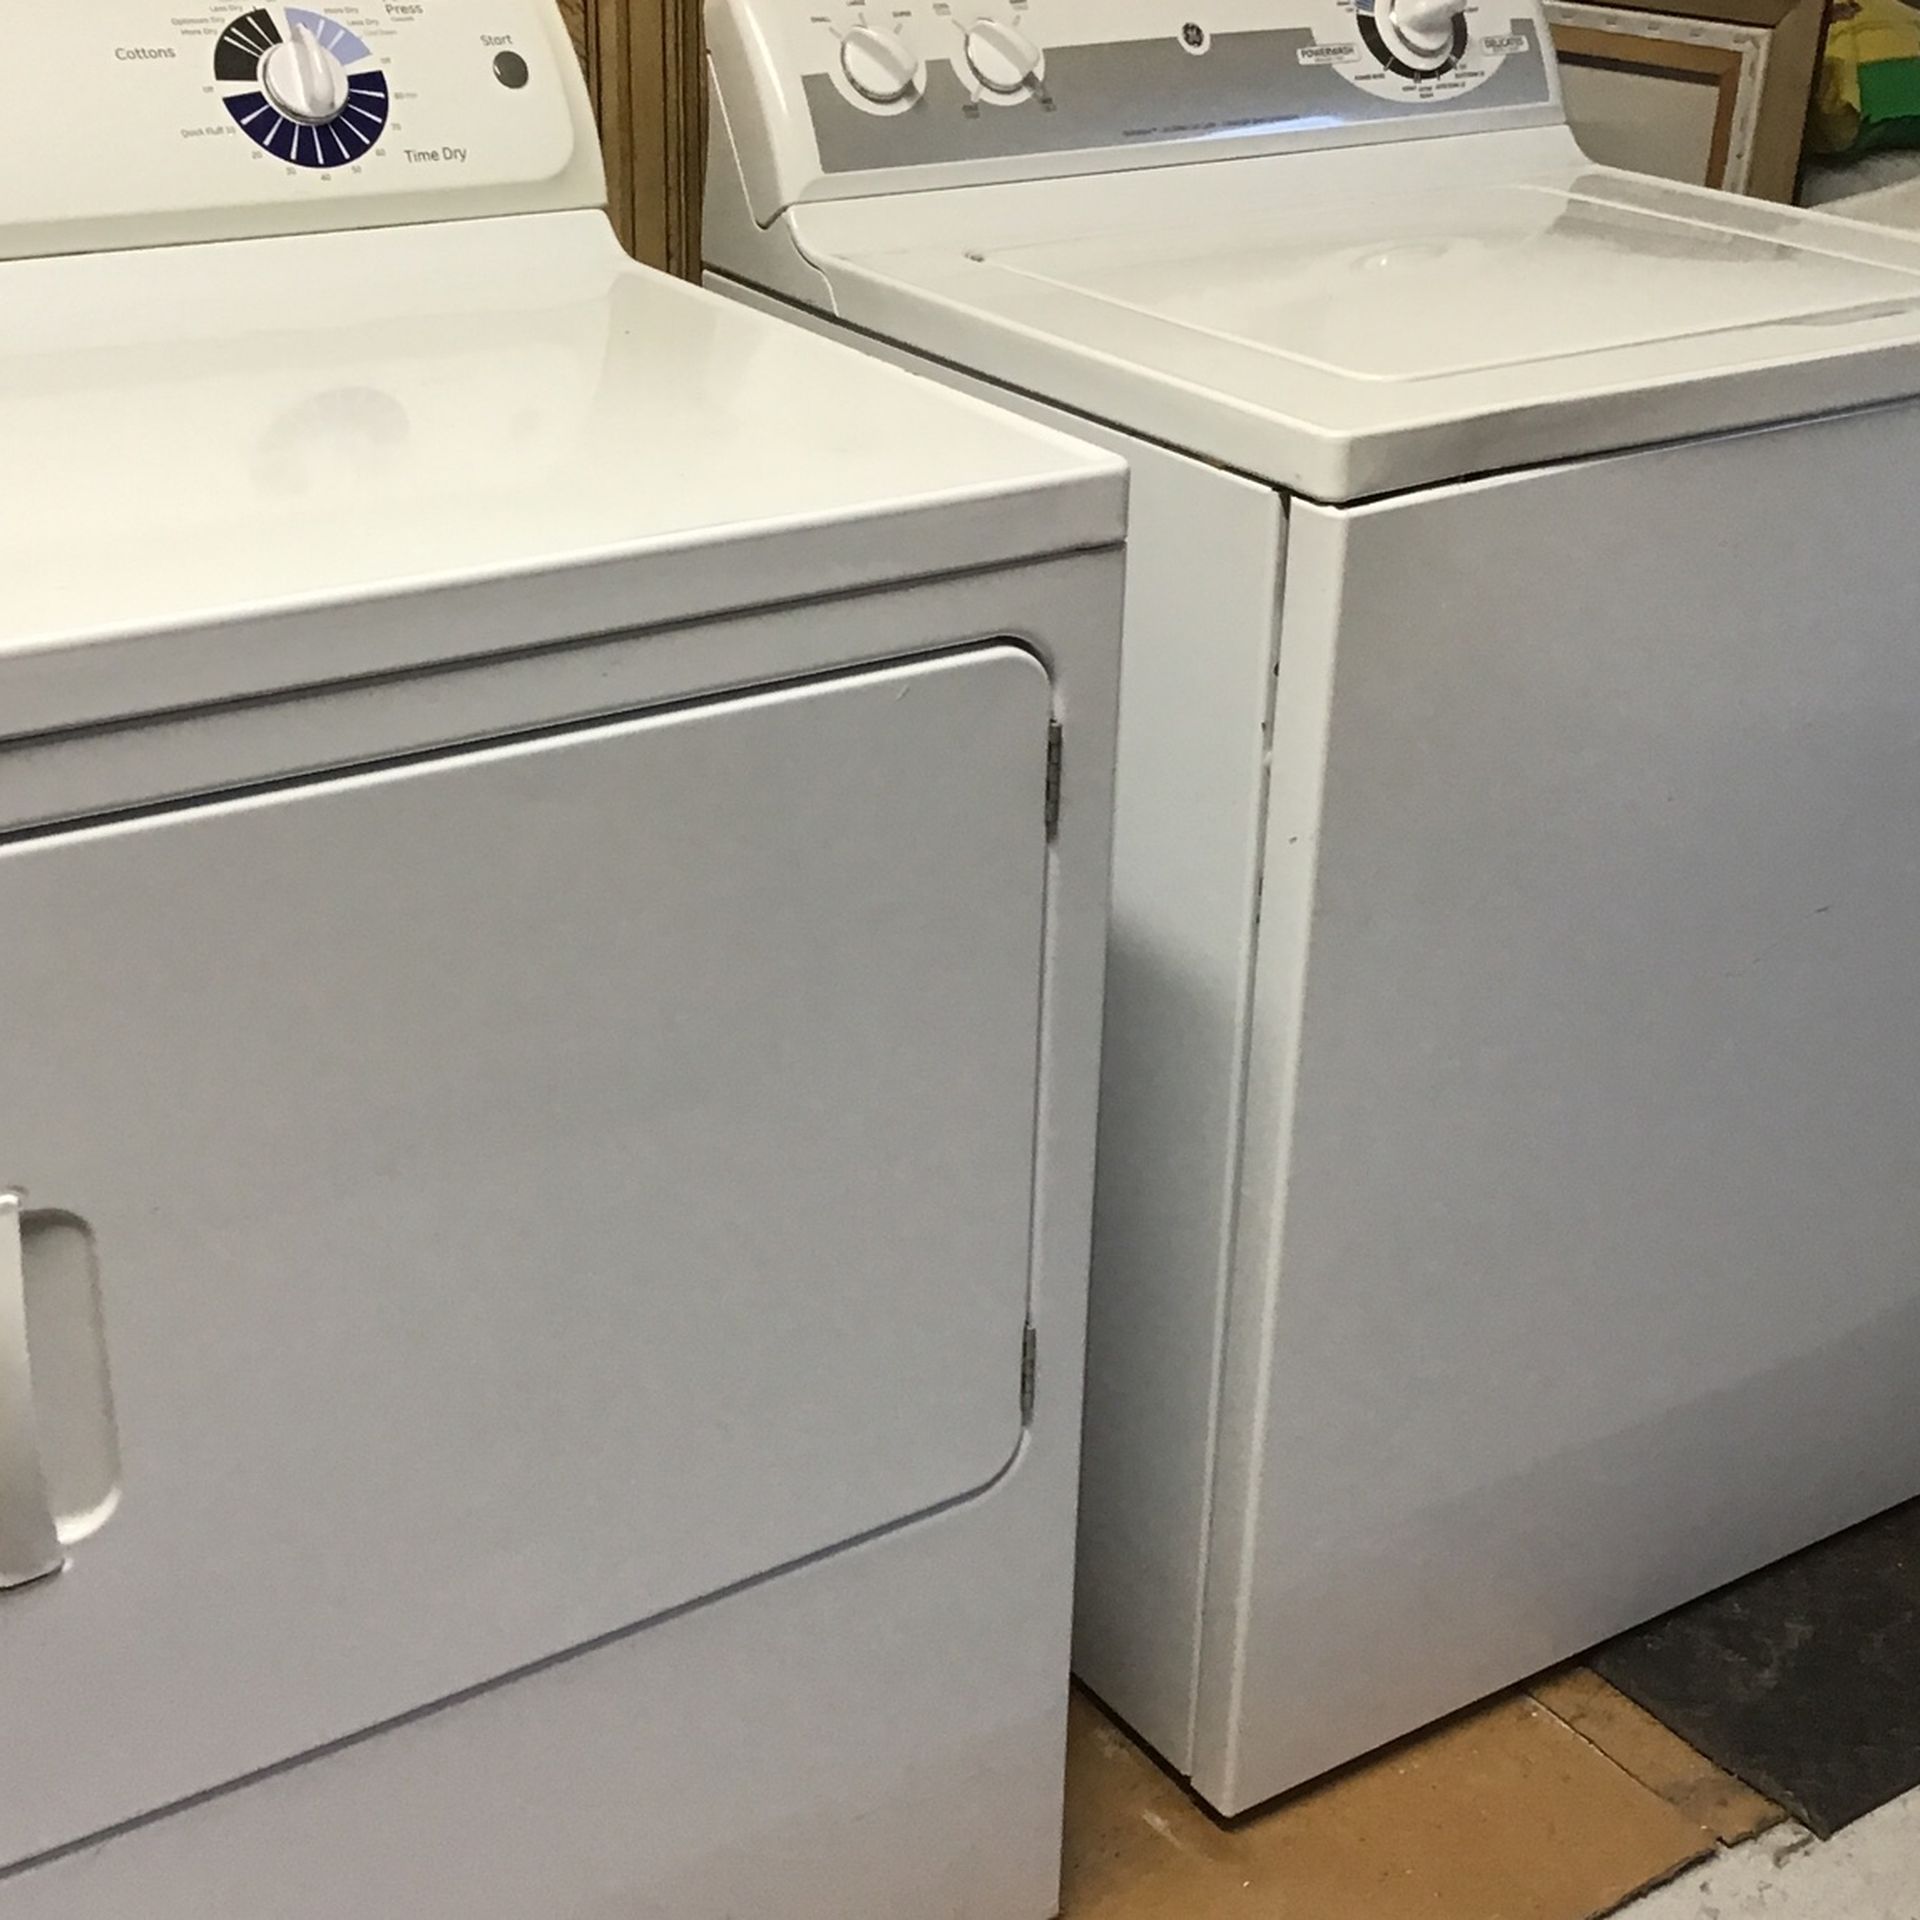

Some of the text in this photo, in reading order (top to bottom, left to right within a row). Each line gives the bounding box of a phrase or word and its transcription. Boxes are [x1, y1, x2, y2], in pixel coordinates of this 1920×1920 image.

[385, 4, 423, 14] Press
[480, 34, 512, 46] Start
[115, 47, 176, 60] Cottons
[1300, 46, 1354, 58] POWERWASH
[404, 147, 467, 163] Time Dry
